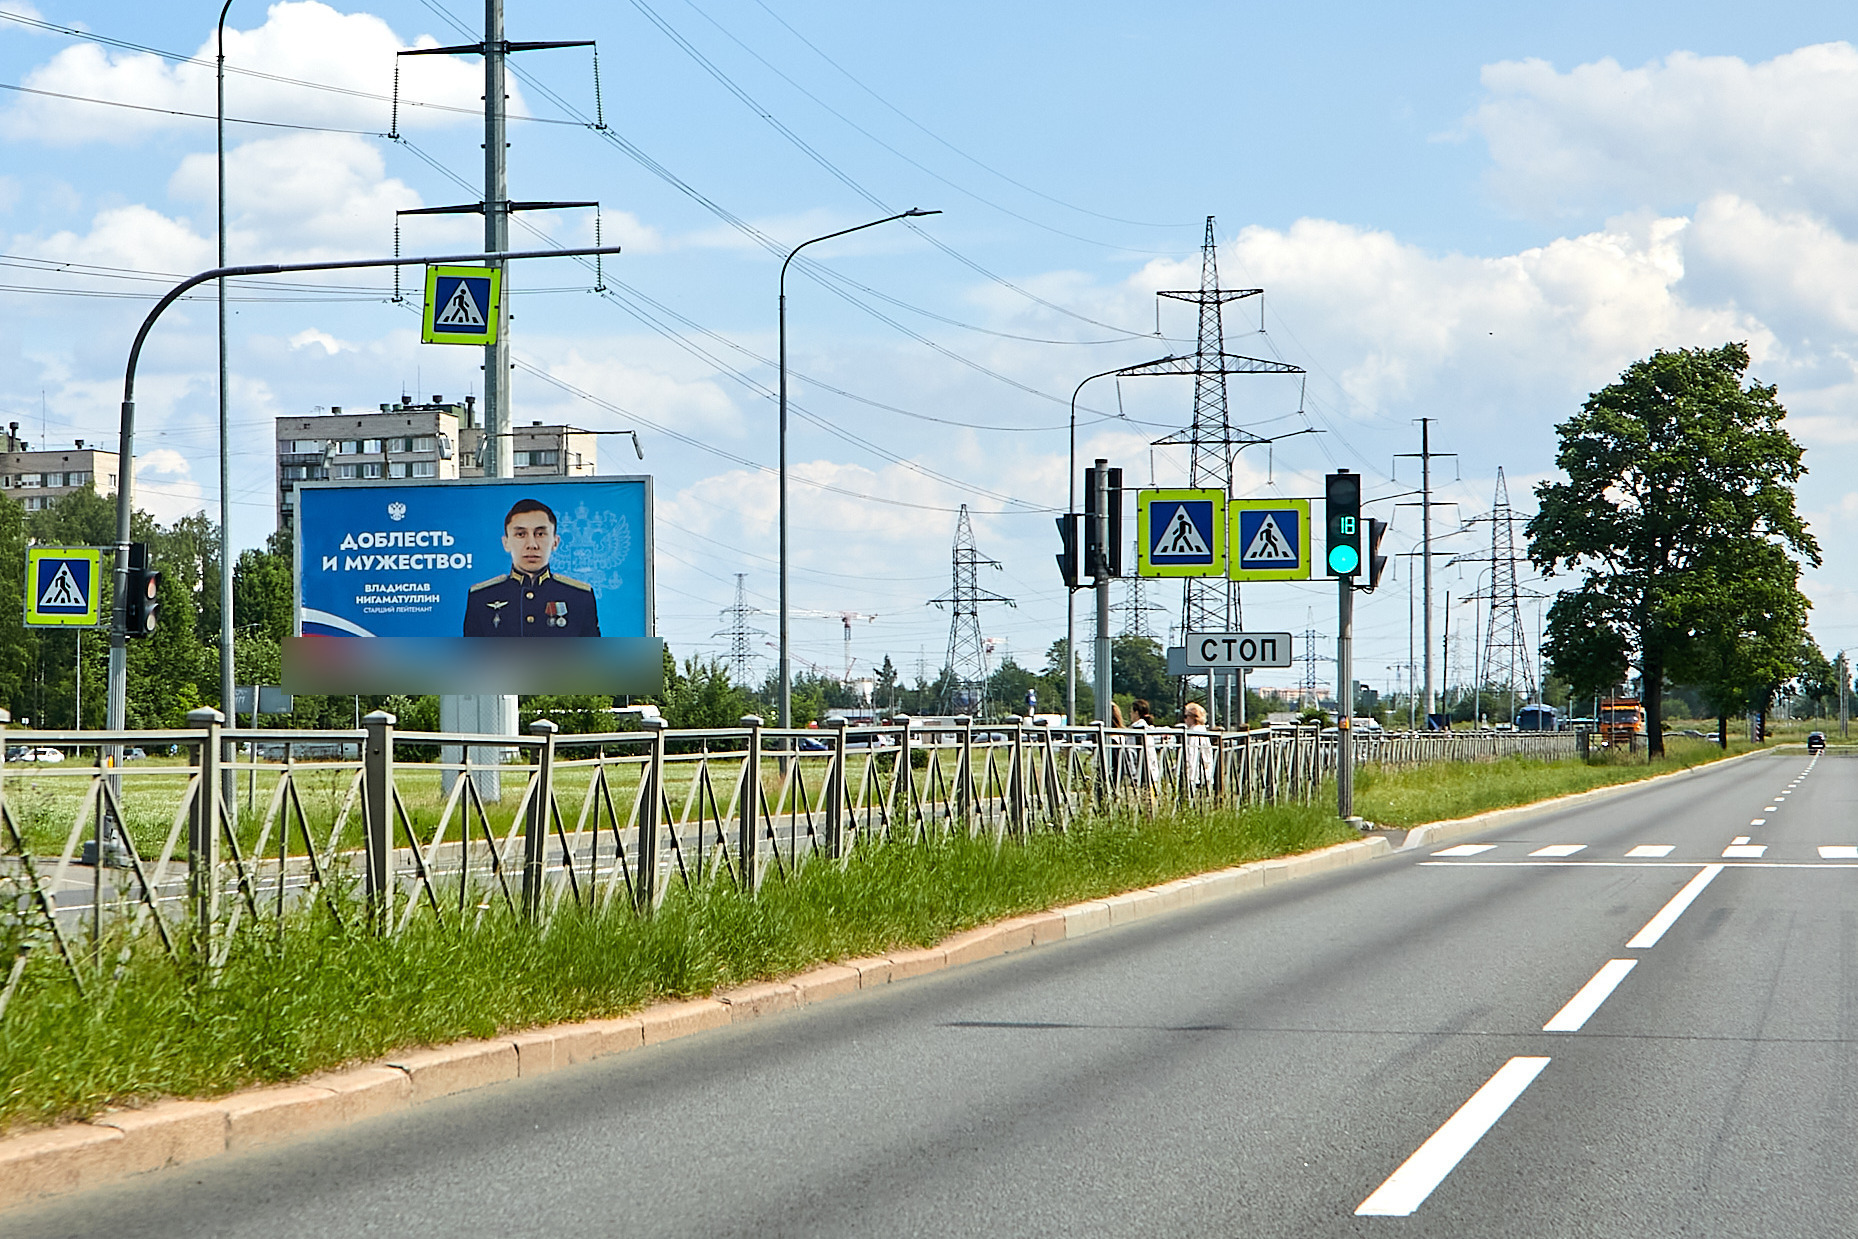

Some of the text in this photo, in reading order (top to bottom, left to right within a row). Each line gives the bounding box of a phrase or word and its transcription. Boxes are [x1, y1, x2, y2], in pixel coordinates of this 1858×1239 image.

[1340, 516, 1355, 535] 18
[340, 531, 455, 551] ДОБЛЕСТЬ
[322, 553, 473, 572] И МУЖЕСТВО!
[364, 583, 431, 593] ВЛАДИСЛАВ
[356, 594, 440, 604] НИГАМАТУЛЛИН
[363, 605, 432, 614] СТАРШИЙ ЛЕЙТЕНАНТ
[1200, 638, 1277, 662] СТОП
